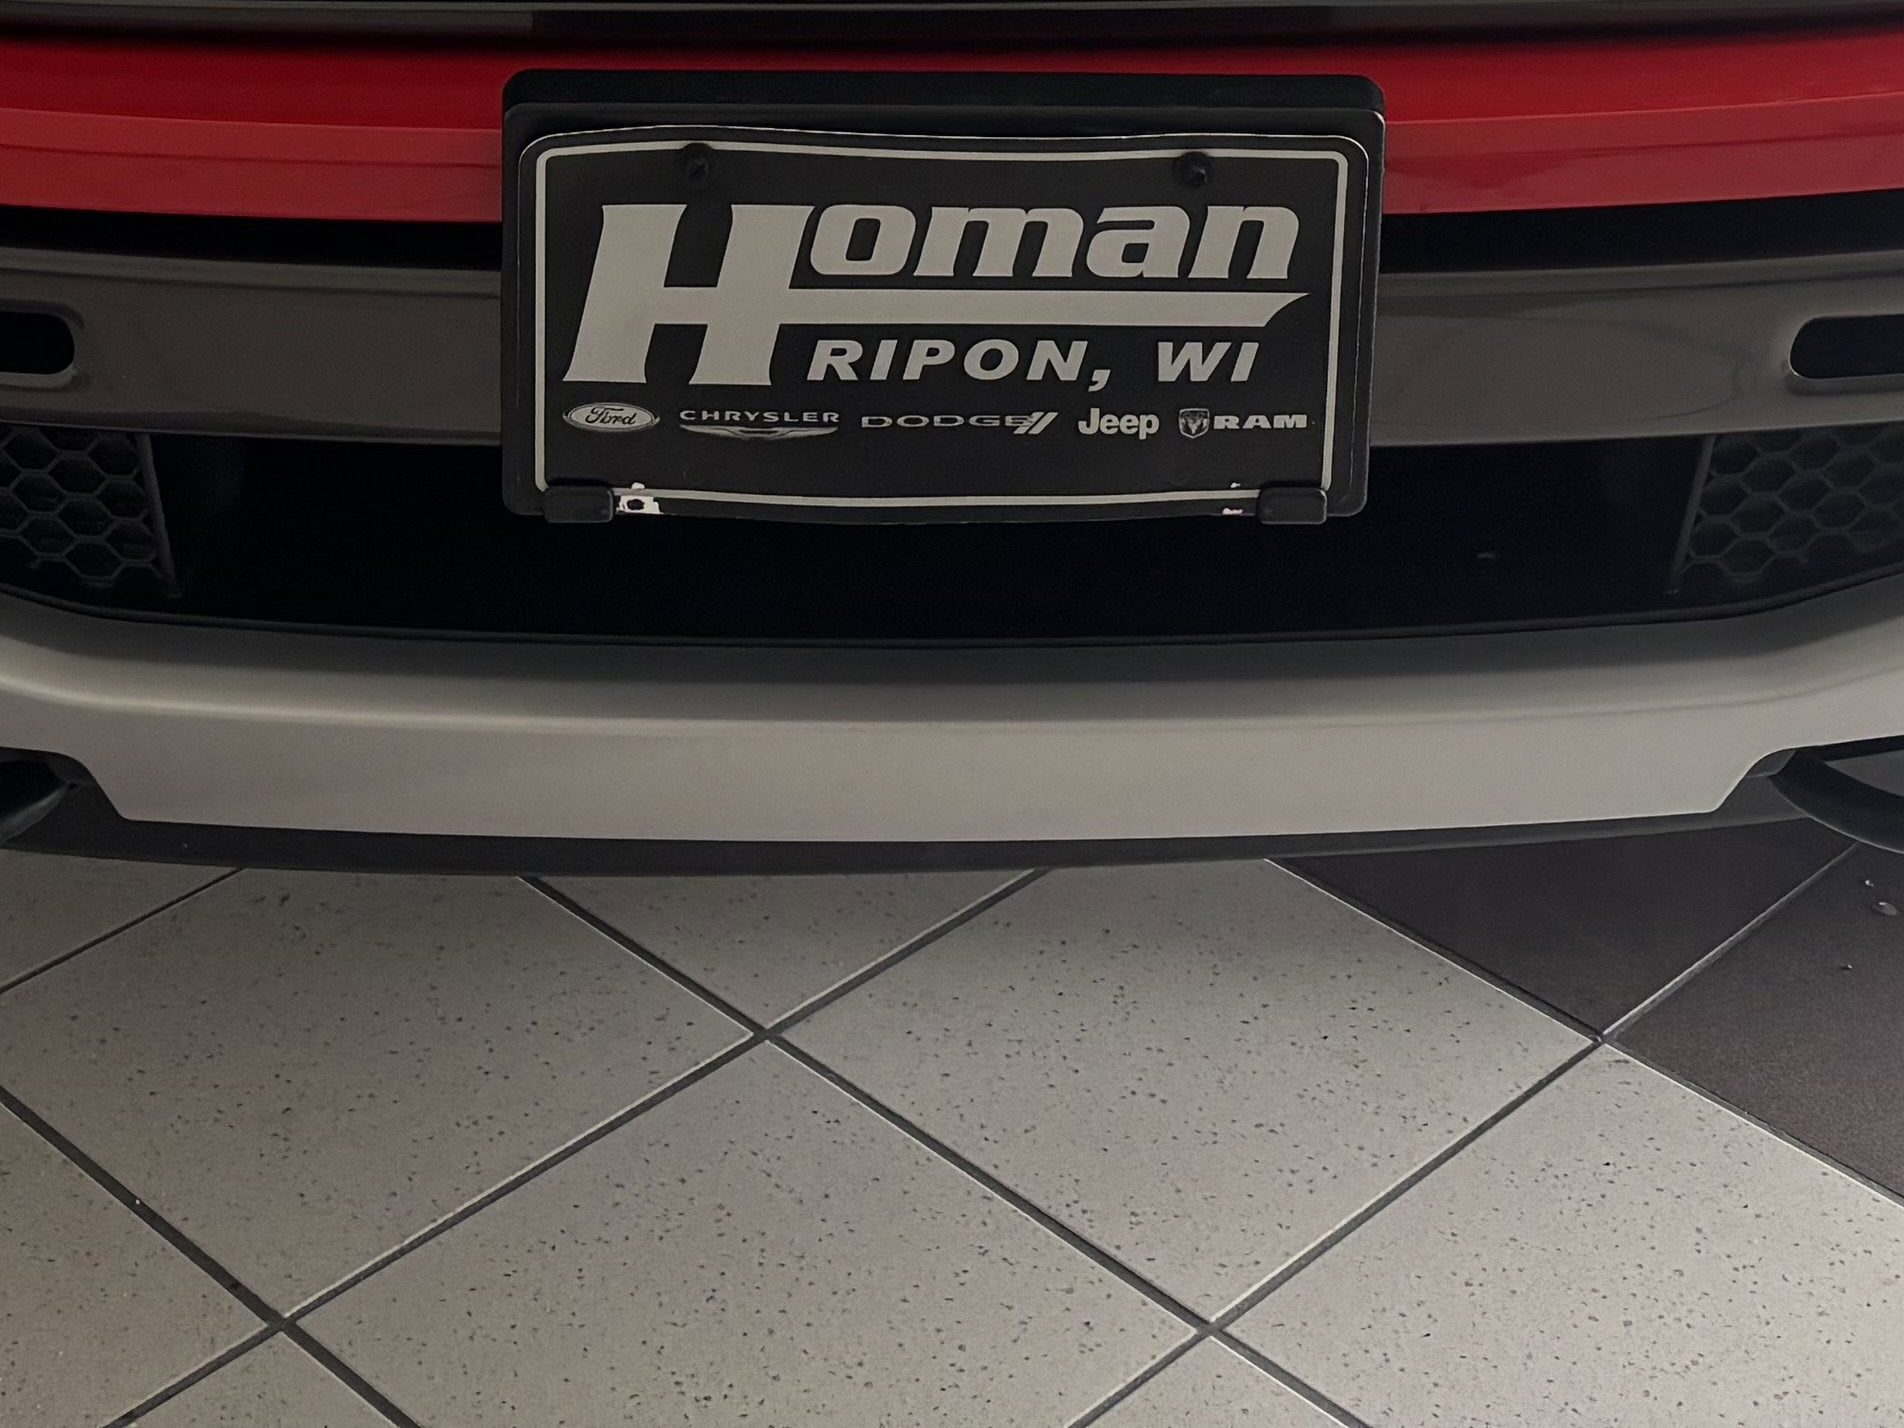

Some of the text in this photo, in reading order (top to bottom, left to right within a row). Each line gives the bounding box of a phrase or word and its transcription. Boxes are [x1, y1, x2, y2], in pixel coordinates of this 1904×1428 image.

[562, 204, 1310, 385] Homan
[807, 339, 1260, 392] RIPON, WI
[679, 409, 840, 423] CHRYSLER
[861, 414, 1037, 428] DODGE
[1077, 407, 1161, 440] Jeep
[1212, 413, 1308, 430] RAM
